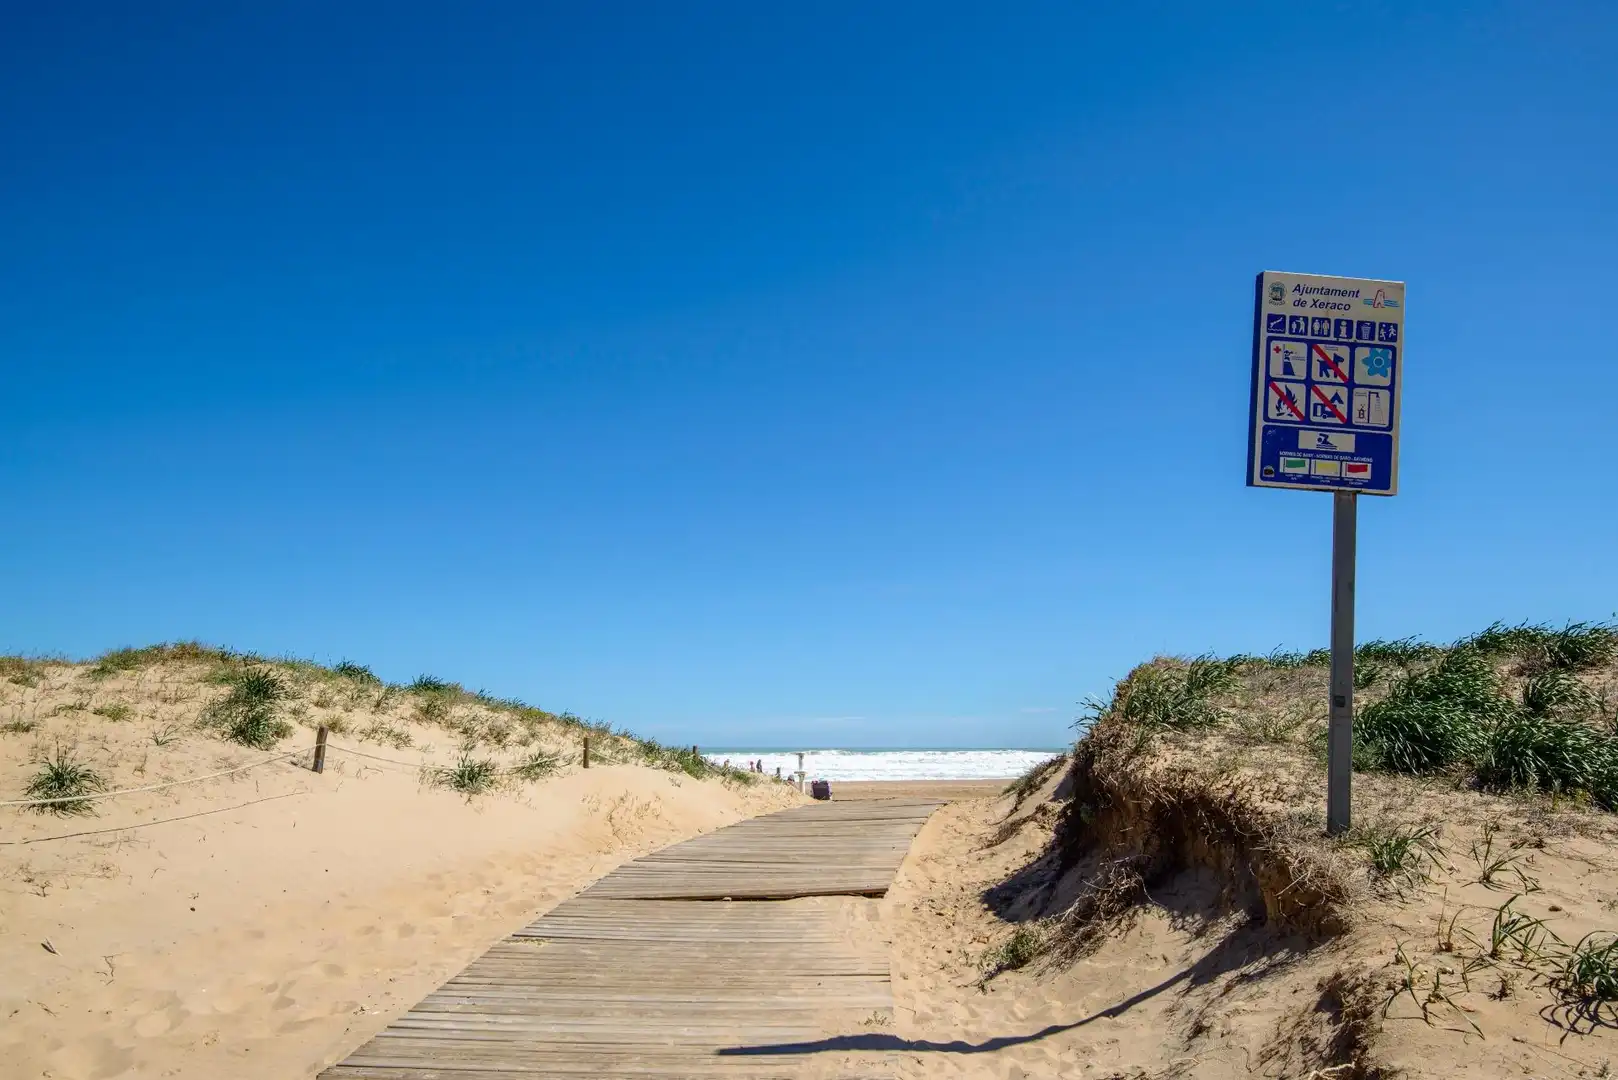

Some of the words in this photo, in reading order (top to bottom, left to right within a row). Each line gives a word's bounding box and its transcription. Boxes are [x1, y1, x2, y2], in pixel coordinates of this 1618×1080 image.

[1292, 283, 1360, 299] Ajuntament
[1292, 297, 1307, 308] de
[1309, 298, 1351, 311] Xeraco
